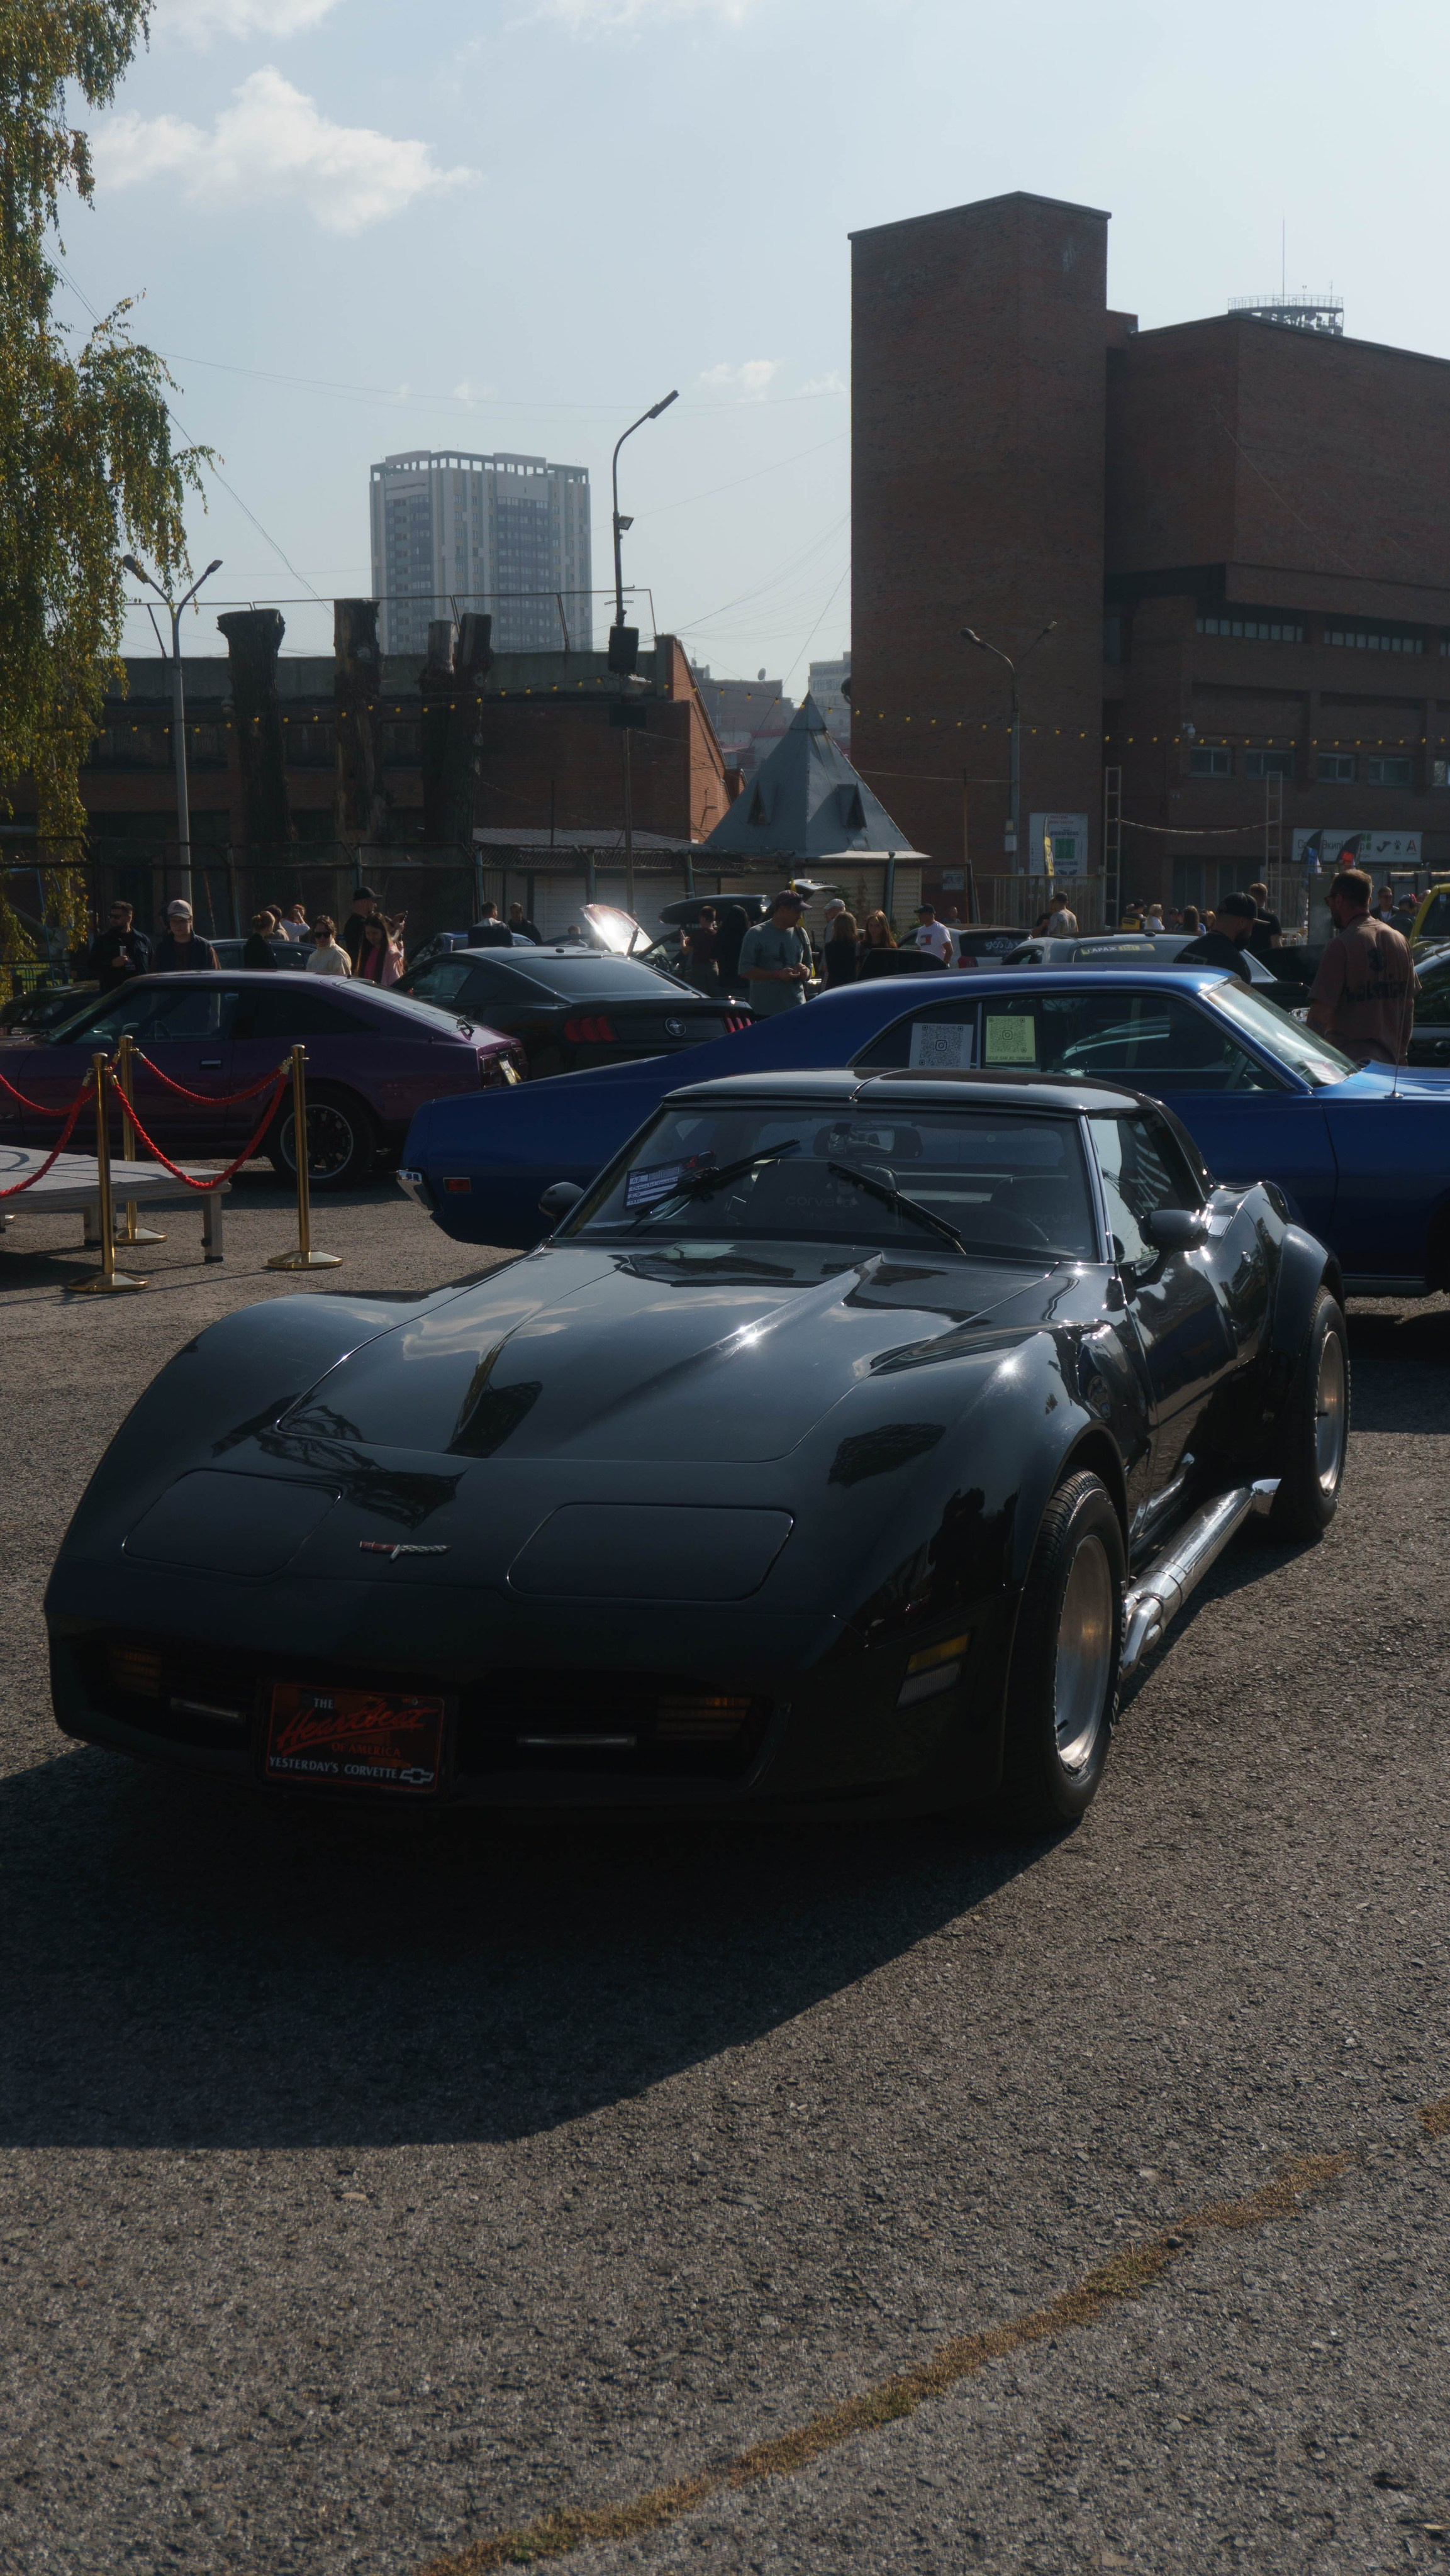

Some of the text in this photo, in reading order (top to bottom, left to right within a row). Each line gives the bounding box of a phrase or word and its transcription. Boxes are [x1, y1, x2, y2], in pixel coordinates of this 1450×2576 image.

[313, 1697, 333, 1709] THE
[276, 1701, 439, 1751] Heartbeat
[331, 1741, 401, 1757] OF AMERICA
[269, 1756, 397, 1779] YESTERDAY'S CORVETTE
